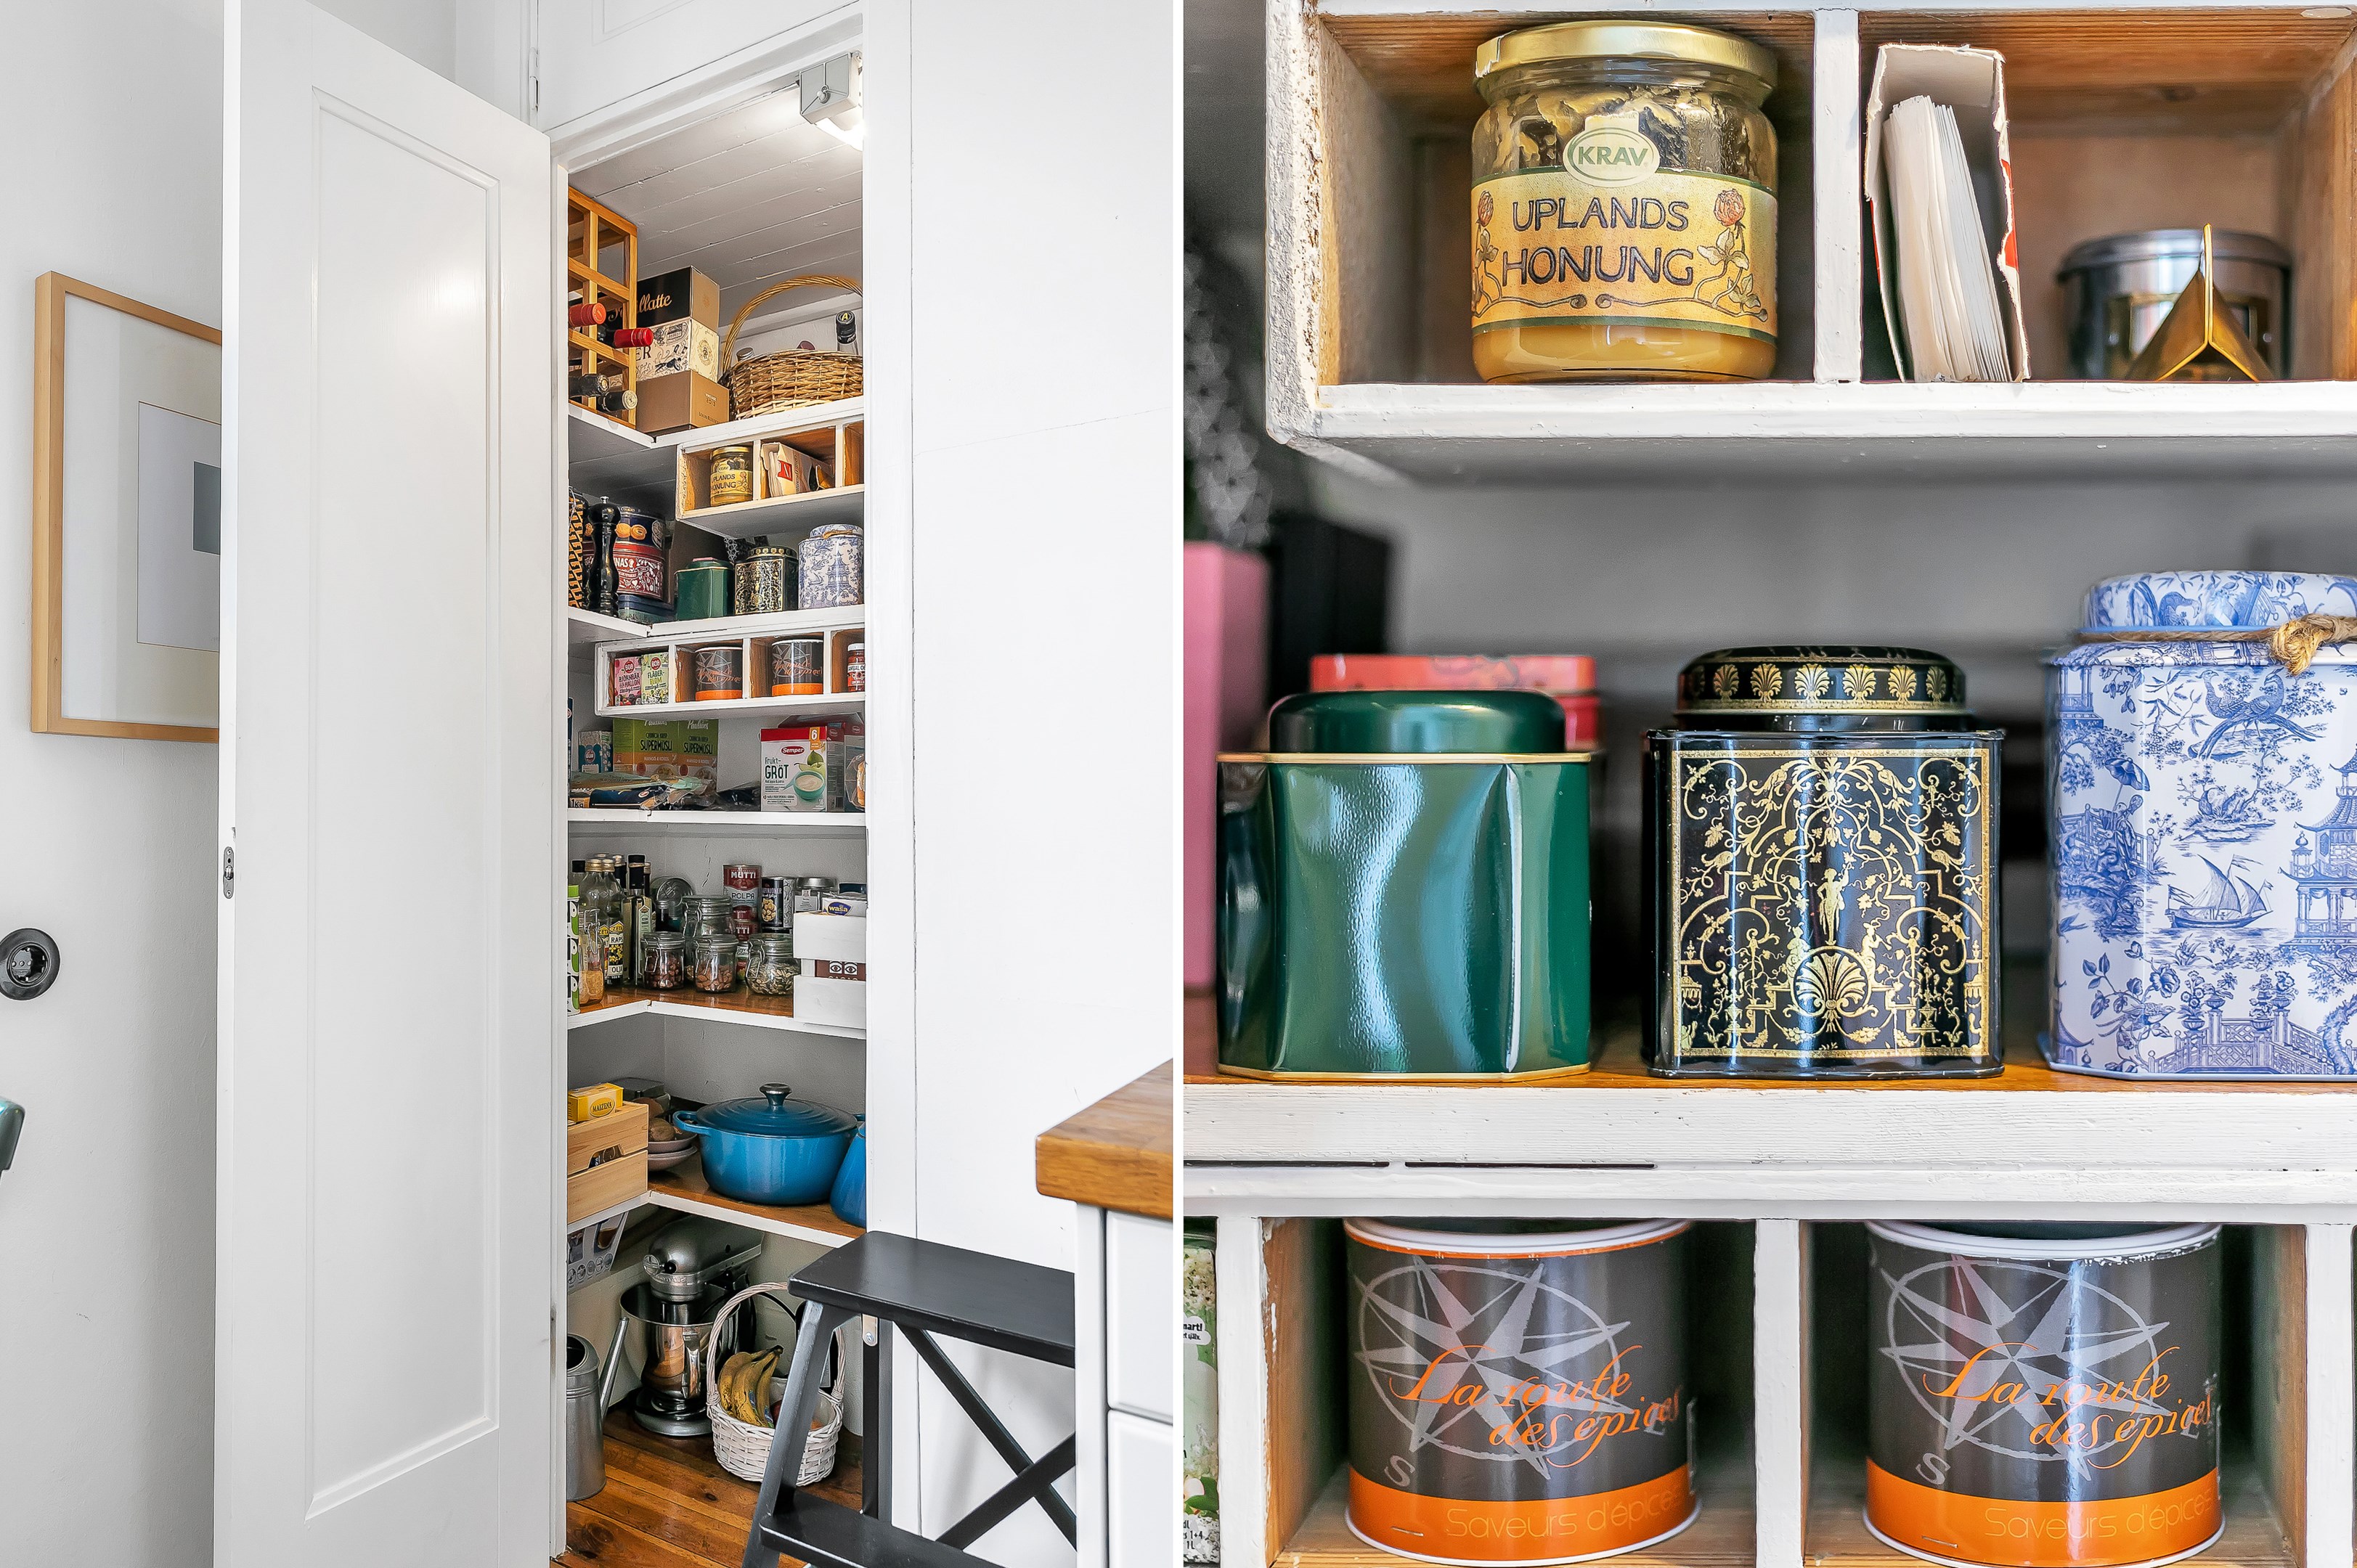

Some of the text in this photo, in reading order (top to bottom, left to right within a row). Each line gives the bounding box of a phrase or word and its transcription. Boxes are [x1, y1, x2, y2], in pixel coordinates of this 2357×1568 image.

[1578, 146, 1648, 166] KRAV
[1512, 197, 1689, 233] UPLANDS
[1502, 245, 1695, 286] HONUNG
[811, 729, 818, 740] 6
[593, 1101, 612, 1112] MAIZENA
[1389, 1344, 1642, 1407] La route
[1923, 1342, 2180, 1406] La route
[1489, 1400, 1574, 1448] des
[2029, 1397, 2114, 1450] des
[1446, 1490, 1674, 1540] Saveurs d'épice
[1984, 1506, 2117, 1540] Saveurs
